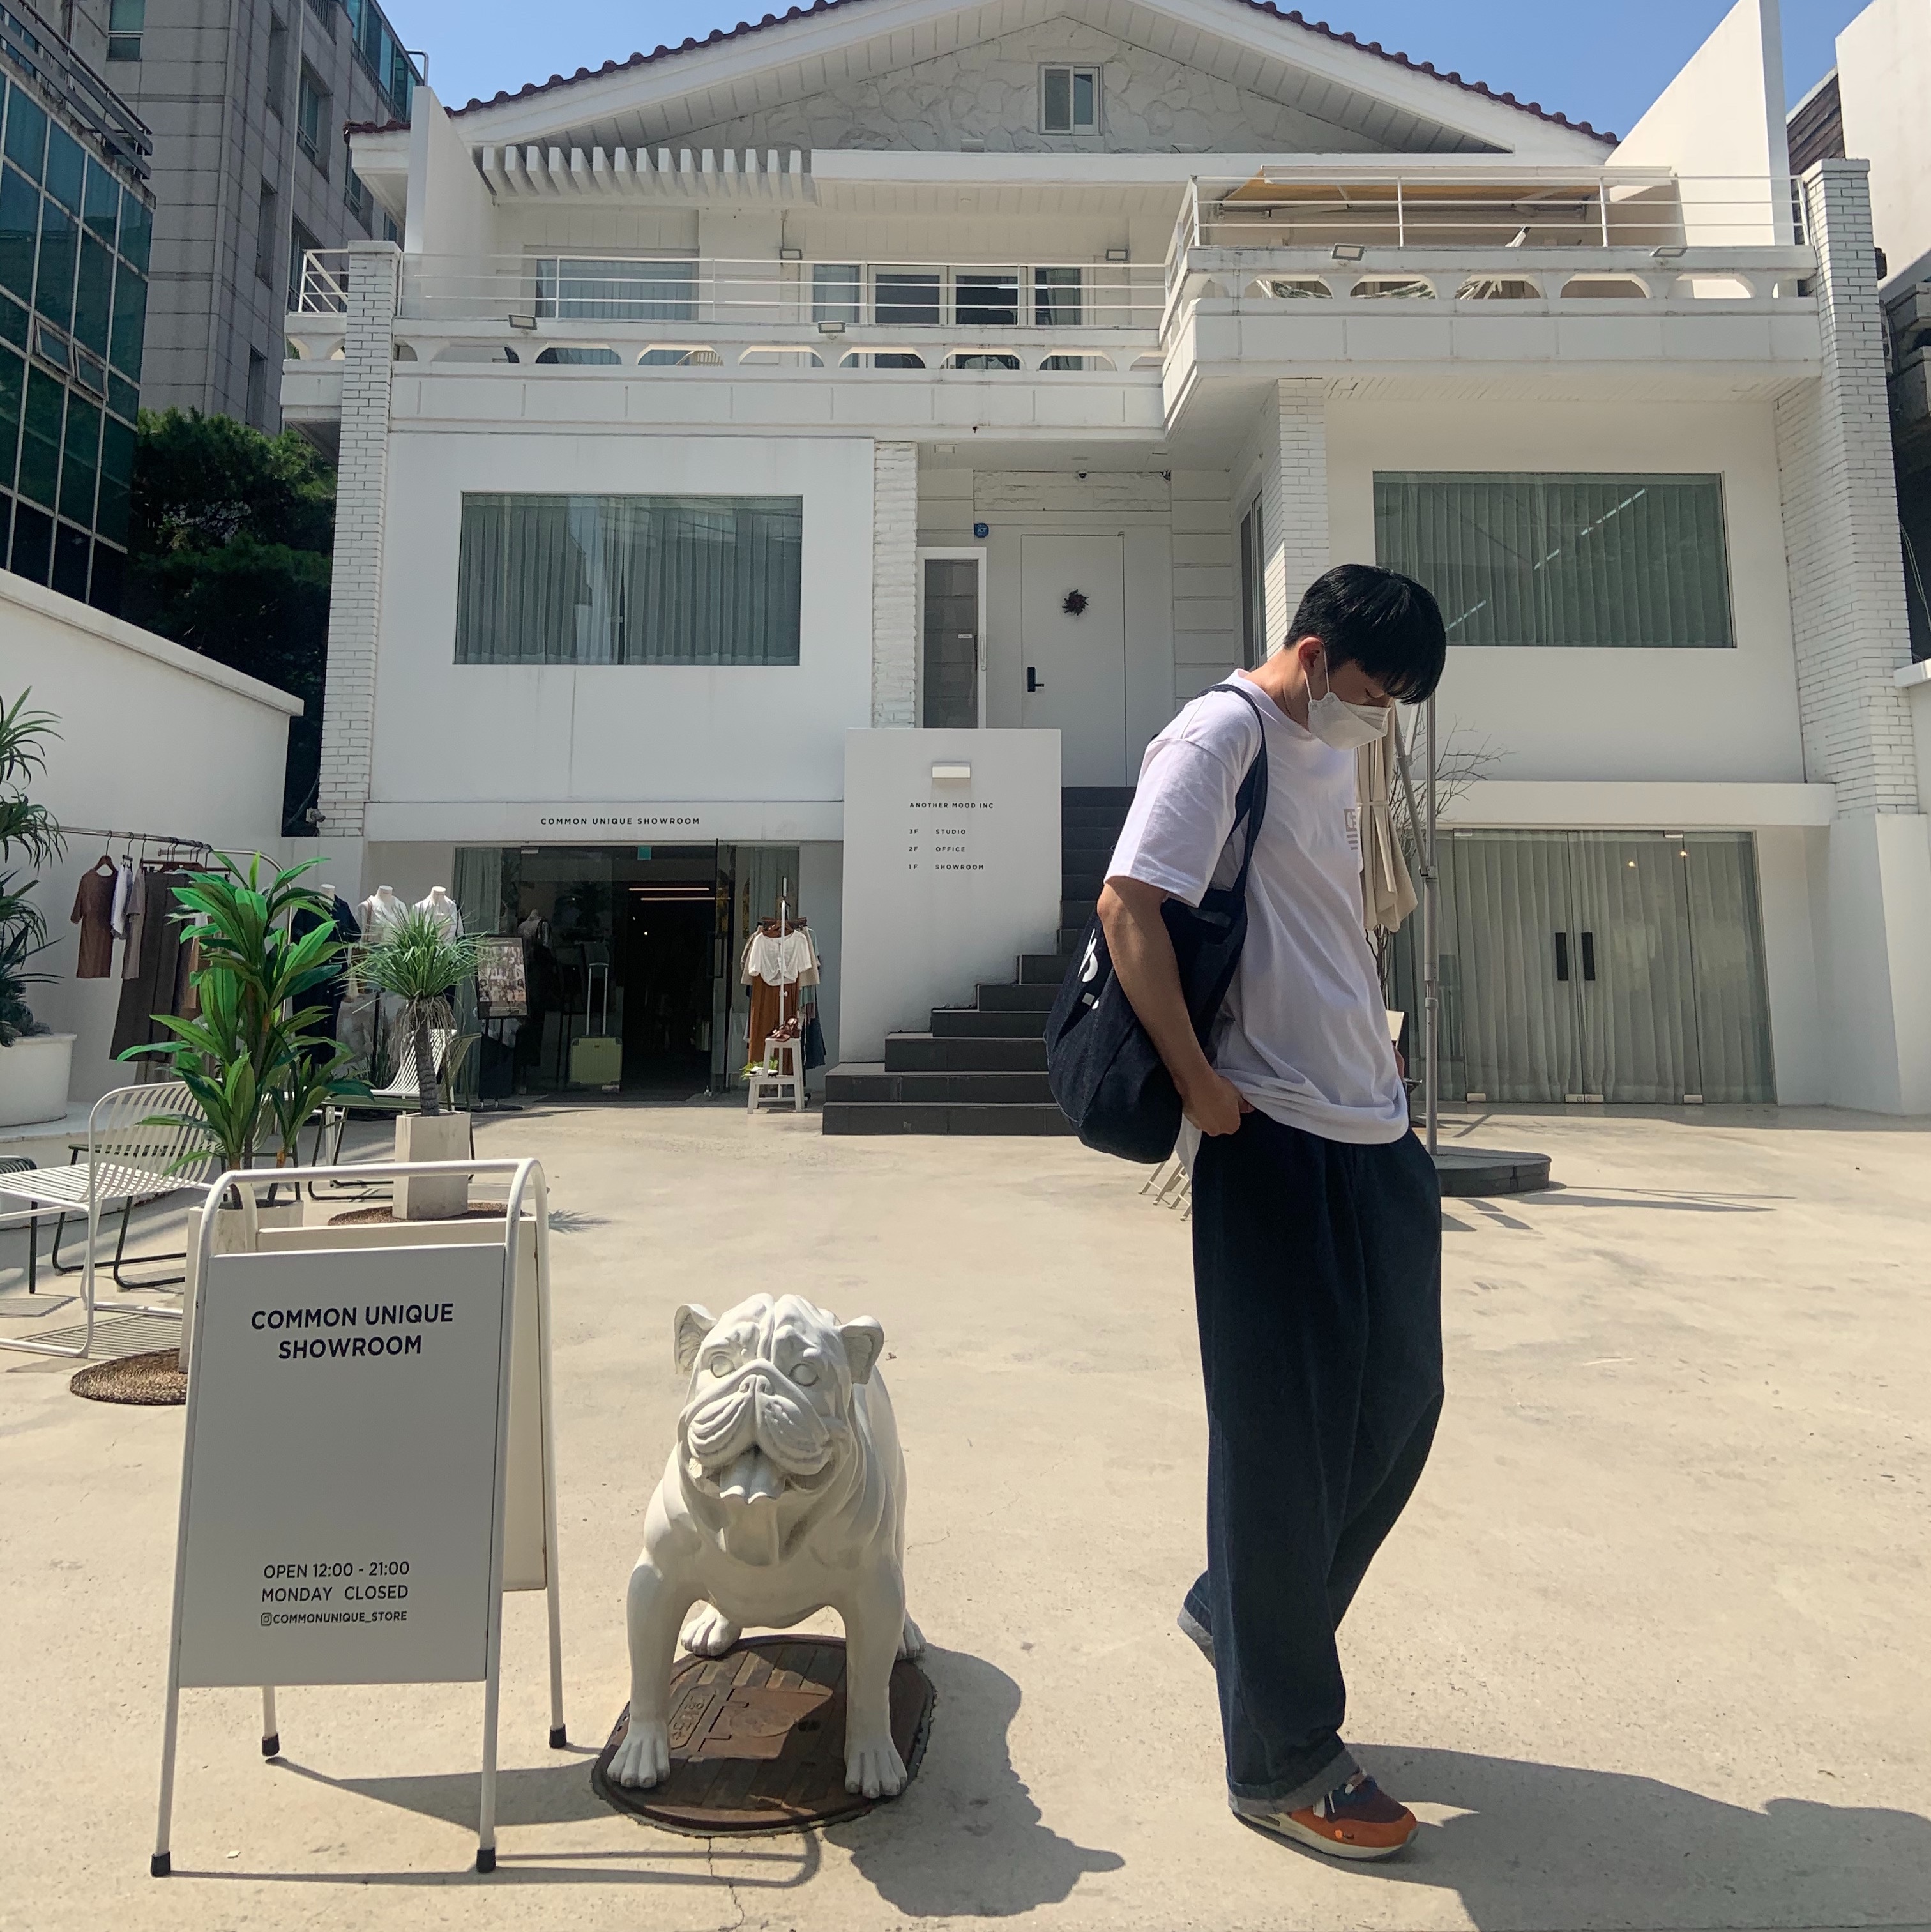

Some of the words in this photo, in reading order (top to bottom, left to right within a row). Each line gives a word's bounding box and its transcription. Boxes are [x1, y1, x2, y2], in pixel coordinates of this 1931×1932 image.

[251, 1307, 358, 1330] COMMON
[365, 1303, 454, 1325] UNIQUE
[278, 1335, 422, 1359] SHOWROOM
[263, 1564, 308, 1579] OPEN
[313, 1563, 354, 1578] 12:00
[368, 1561, 410, 1576] 21:00
[262, 1586, 333, 1602] MONDAY
[344, 1585, 409, 1601] CLOSED
[273, 1611, 407, 1624] COMMONUNIQUE_STORE
